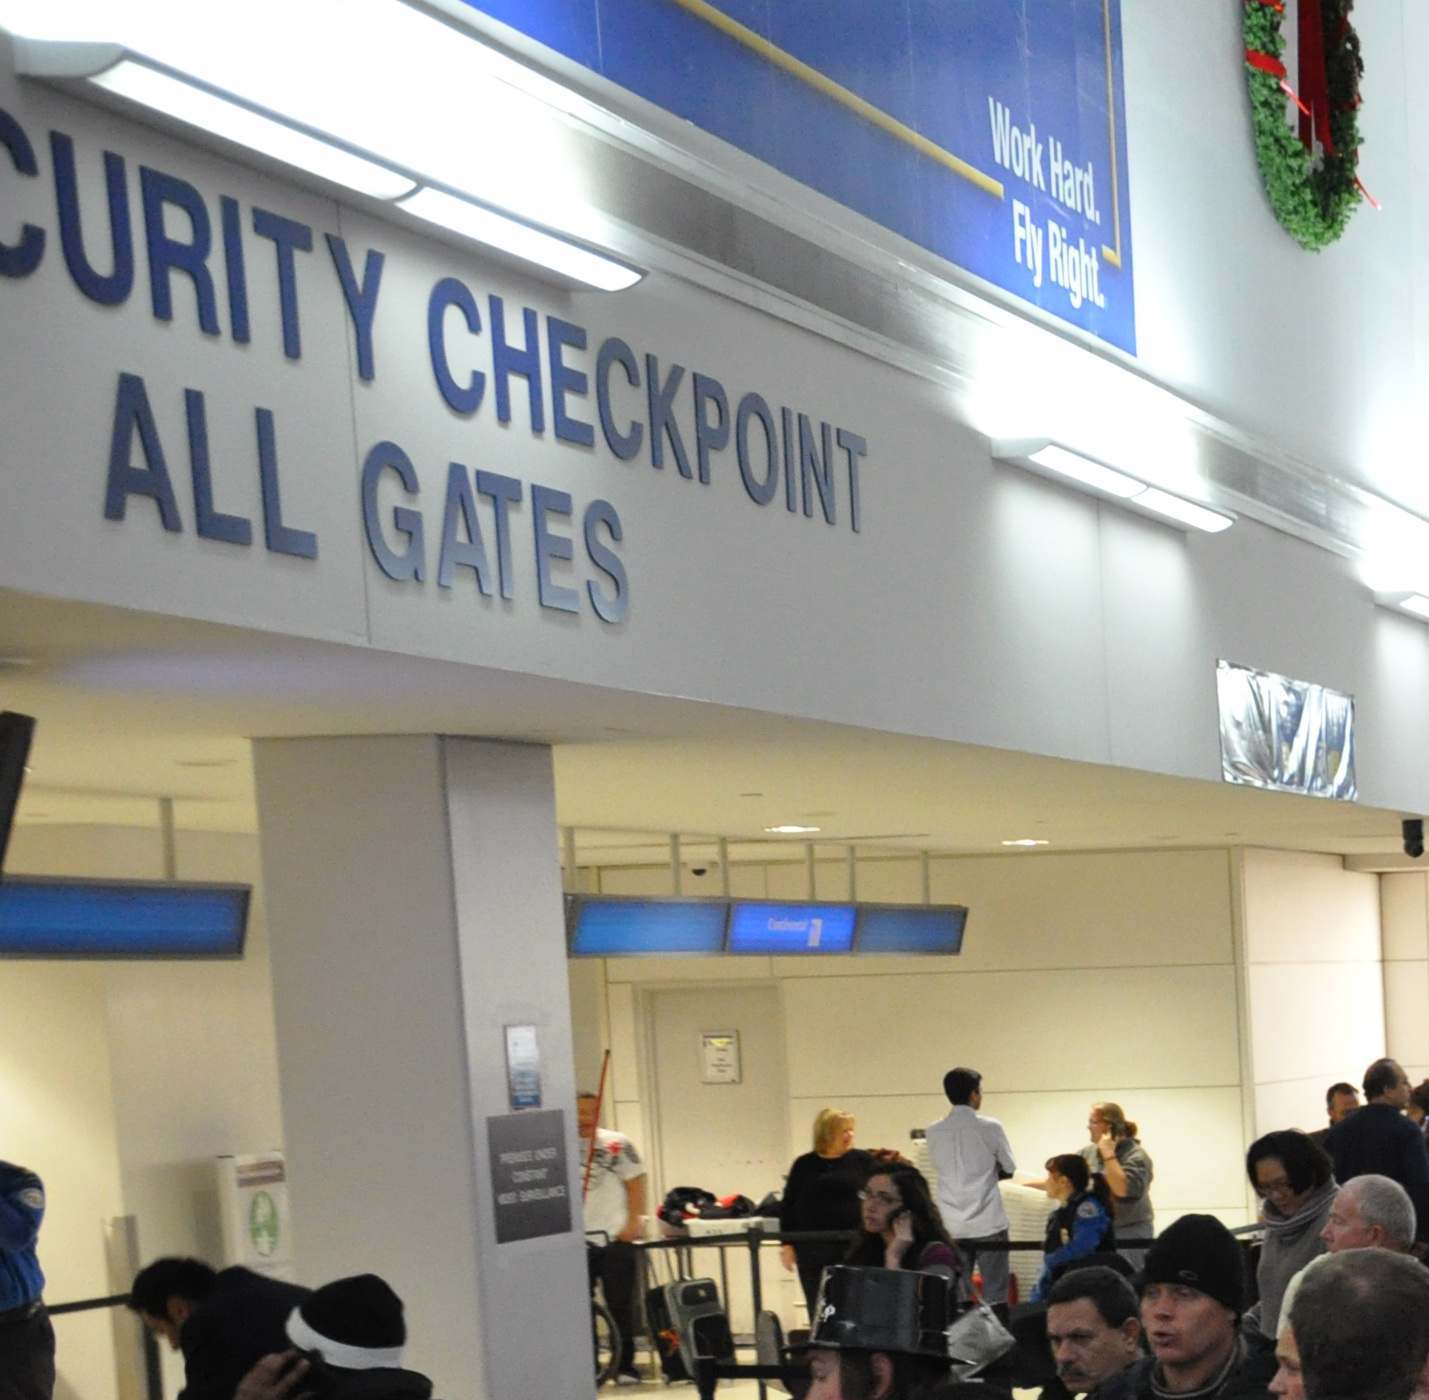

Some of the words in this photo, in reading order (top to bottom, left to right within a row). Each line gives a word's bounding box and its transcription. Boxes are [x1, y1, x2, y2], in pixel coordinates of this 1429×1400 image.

[988, 96, 1045, 191] Work
[1049, 136, 1101, 225] Hard.
[1012, 199, 1043, 289] Fly
[1050, 219, 1105, 309] Right.
[103, 371, 319, 561] ALL
[361, 440, 630, 624] GATES
[428, 276, 868, 534] CHECKPOINT
